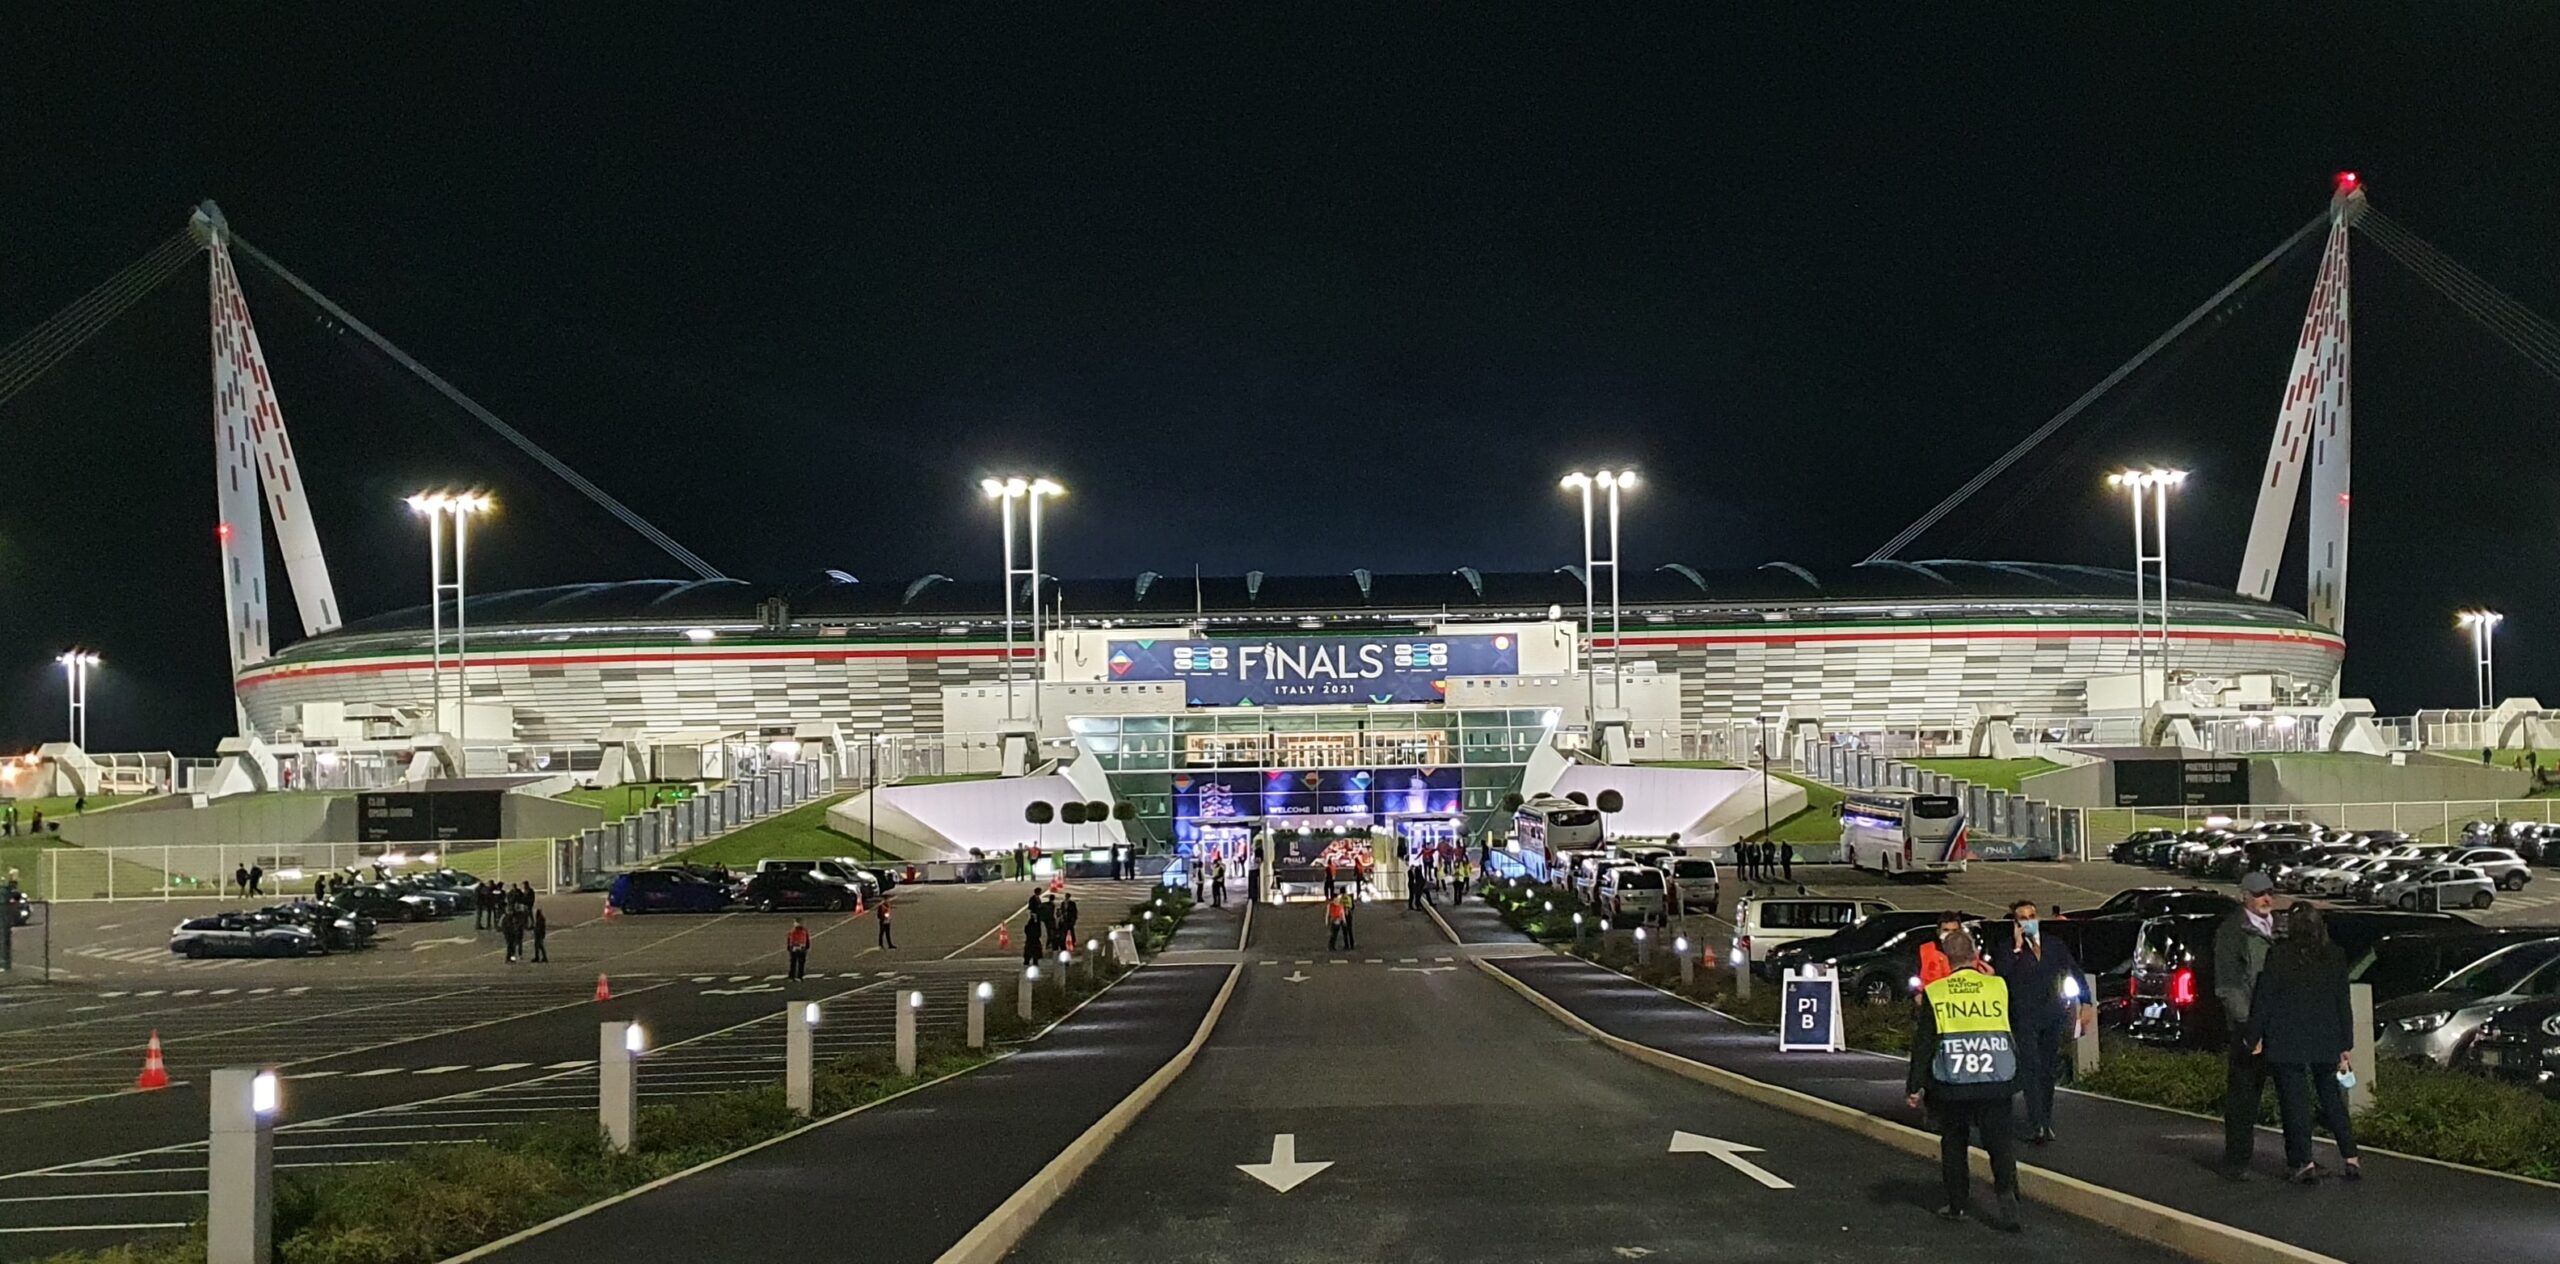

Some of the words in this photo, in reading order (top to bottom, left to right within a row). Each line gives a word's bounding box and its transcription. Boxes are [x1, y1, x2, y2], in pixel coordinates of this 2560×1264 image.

[1239, 642, 1384, 680] FINALS
[1274, 685, 1315, 695] ITALY
[1322, 684, 1355, 694] 2021
[1269, 806, 1310, 814] WELCOME
[1948, 987, 1981, 995] LEAGUE
[1798, 998, 1818, 1013] P1
[1934, 1000, 2002, 1019] FINALS
[1801, 1014, 1815, 1029] B
[1939, 1036, 2009, 1054] TEWARD
[1950, 1053, 1995, 1074] 782
